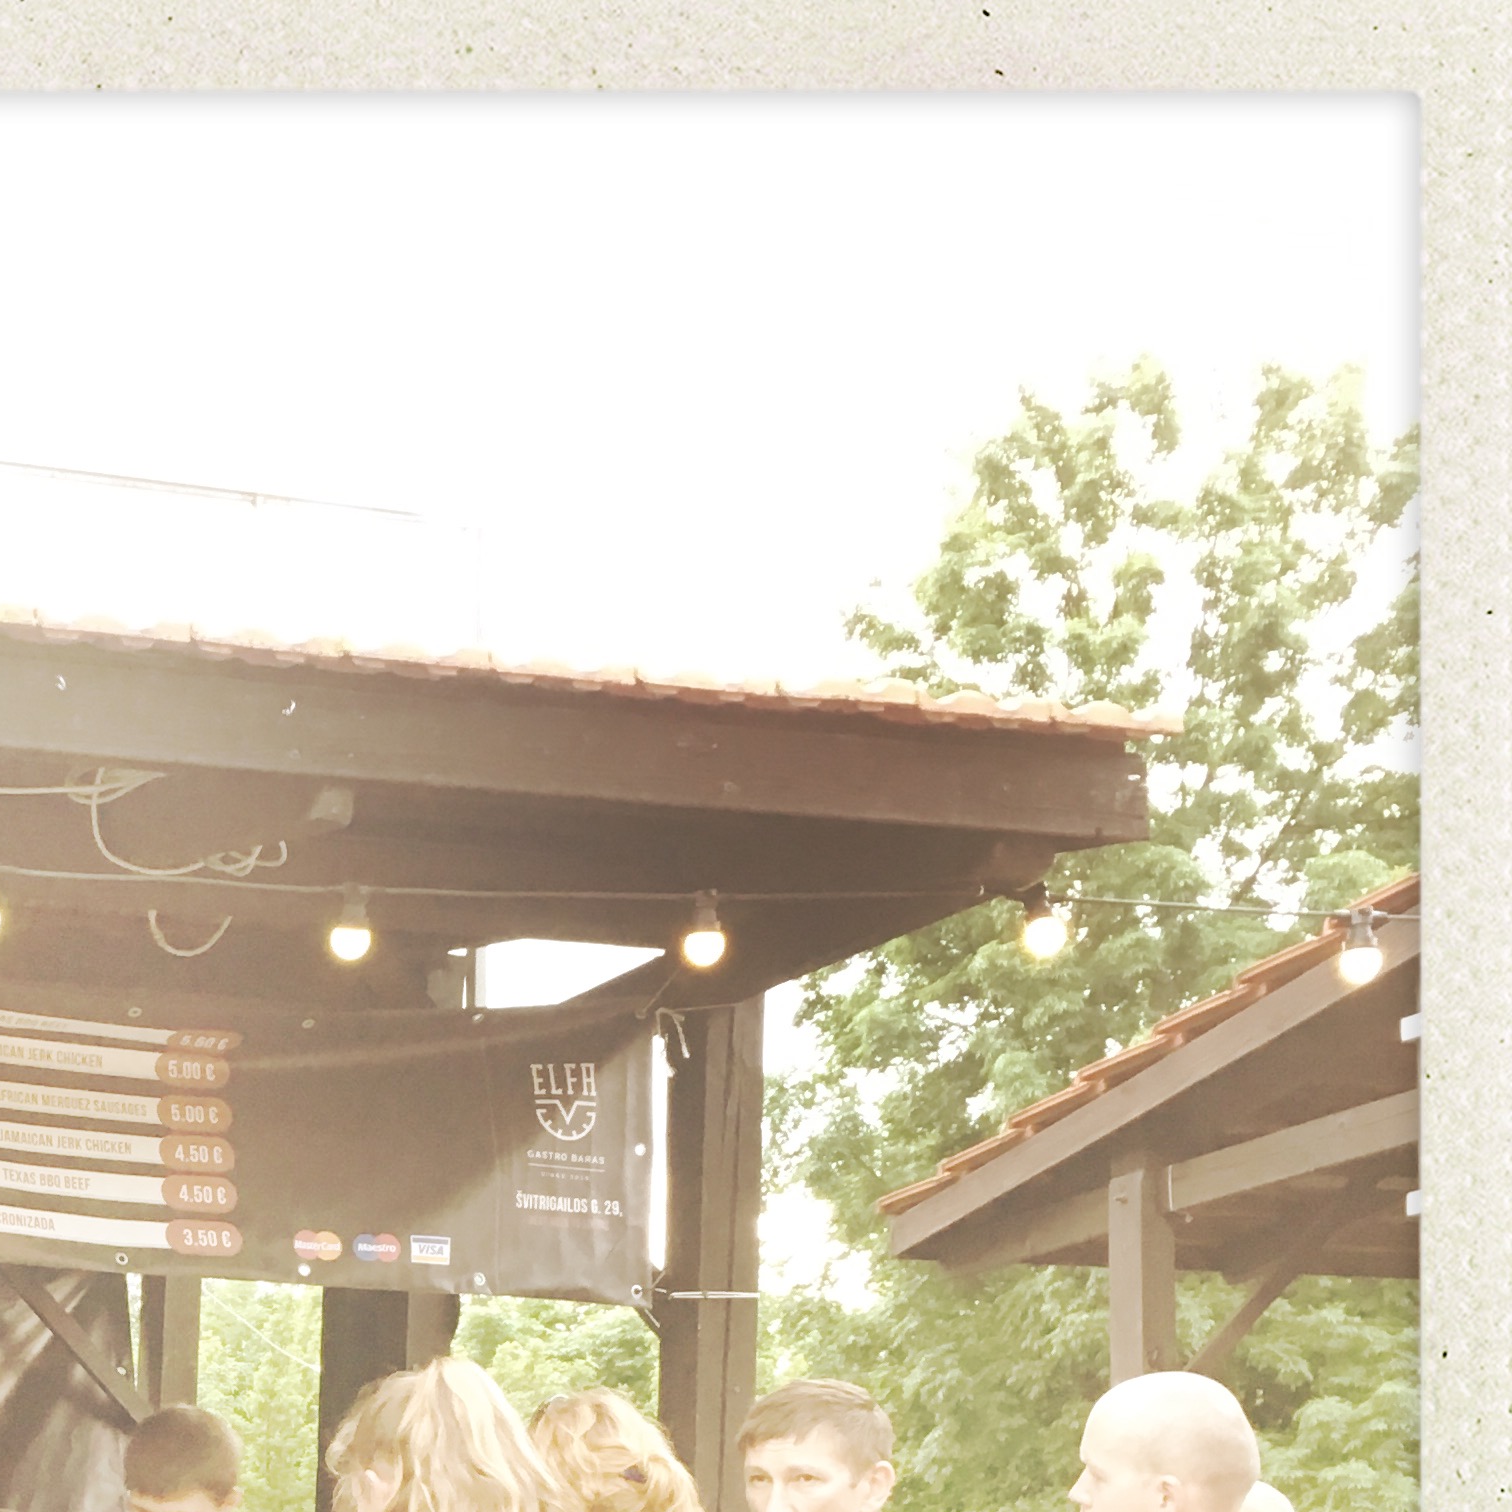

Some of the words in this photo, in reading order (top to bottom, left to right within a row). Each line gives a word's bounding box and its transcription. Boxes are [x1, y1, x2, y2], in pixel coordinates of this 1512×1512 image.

[28, 1047, 54, 1062] JERK
[56, 1049, 103, 1068] CHICKEN
[168, 1060, 201, 1080] 5.00
[206, 1063, 216, 1081] €
[41, 1093, 91, 1112] MERGUEZ
[93, 1099, 147, 1117] SAUSAGES
[171, 1104, 205, 1123] 5.00
[209, 1106, 218, 1124] €
[0, 1127, 53, 1148] JAMAICAN
[56, 1135, 82, 1151] JERK
[85, 1138, 132, 1155] CHICKEN
[175, 1144, 208, 1163] 4.50
[213, 1146, 223, 1164] €
[2, 1168, 36, 1186] TEXAS
[40, 1173, 61, 1189] BBQ
[64, 1176, 91, 1191] BEEF
[179, 1184, 213, 1203] 4.50
[217, 1186, 227, 1204] €
[183, 1227, 217, 1248] 3.50
[221, 1230, 232, 1249] €
[357, 1242, 397, 1253] Maestro
[418, 1244, 444, 1256] VISA
